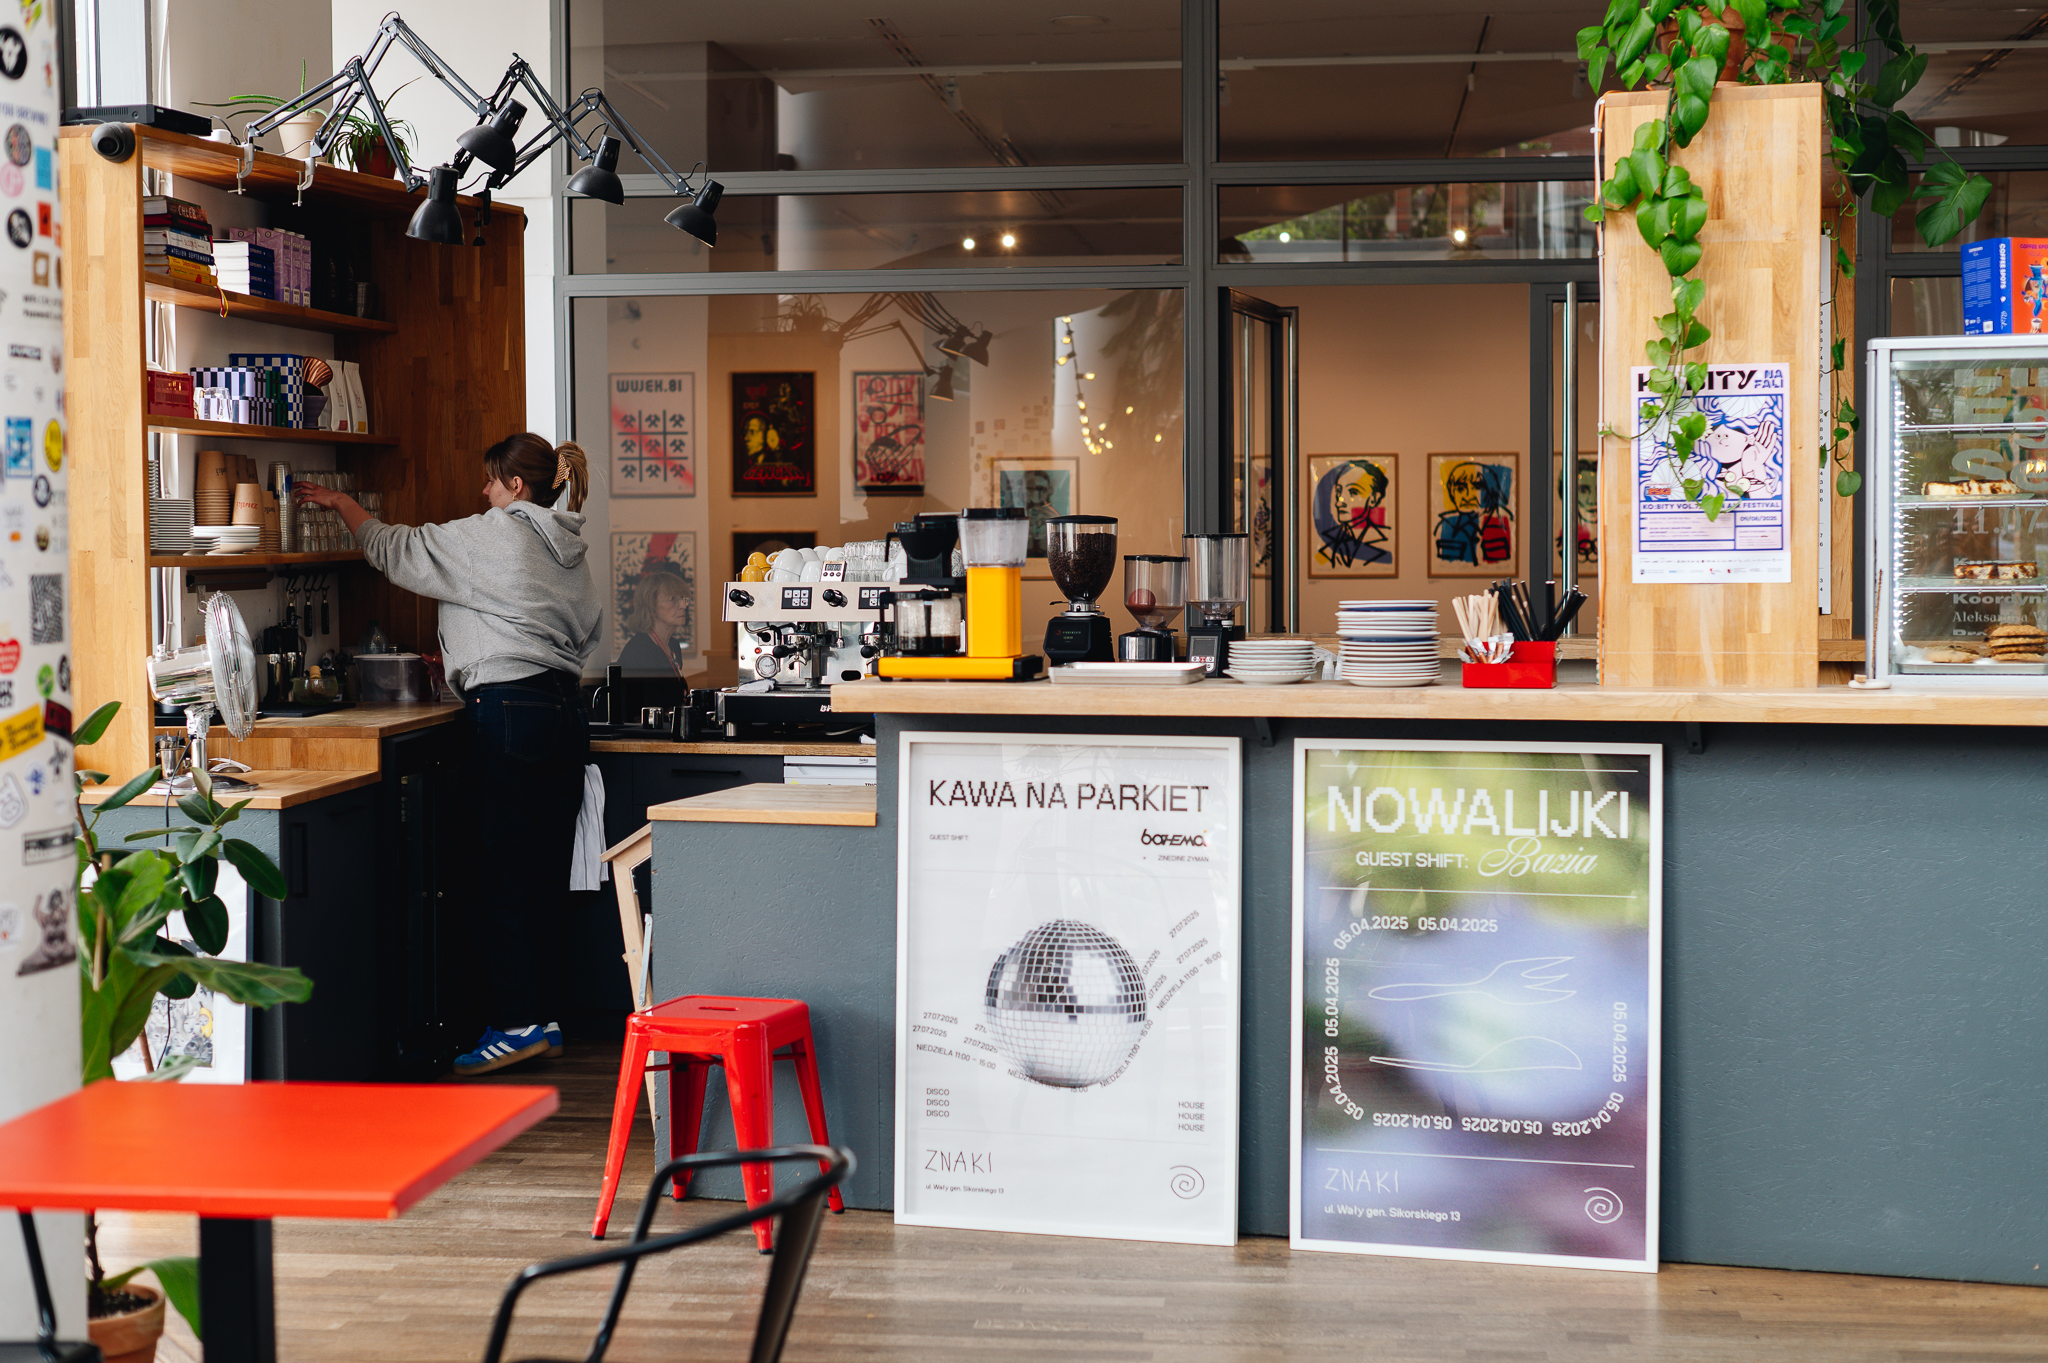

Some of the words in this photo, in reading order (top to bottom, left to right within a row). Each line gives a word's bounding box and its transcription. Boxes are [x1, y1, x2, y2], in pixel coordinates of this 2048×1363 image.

[1999, 243, 2007, 268] COFFEE
[1764, 370, 1783, 379] NA
[1743, 501, 1780, 509] FESTIVAL
[930, 780, 1016, 808] KAWA
[1027, 782, 1067, 809] NA
[1077, 783, 1209, 812] PARKIET
[1327, 785, 1629, 839] NOWALIJKI
[1355, 851, 1412, 867] GUEST
[1415, 852, 1469, 868] SHIFT:
[1477, 835, 1599, 877] Bazia
[1333, 915, 1409, 950] 05.04.2025
[1418, 917, 1498, 933] 05.04.2025
[1156, 979, 1186, 1011] NIEDZIELA
[1325, 957, 1340, 1037] 05.04.2025
[916, 1043, 953, 1056] NIEDZIELA
[1612, 1001, 1627, 1083] 05.04.2025
[1100, 1059, 1131, 1088] NIEDZIELA
[1325, 1046, 1364, 1120] 05.04.2025
[926, 1088, 950, 1096] DISCO
[926, 1099, 950, 1107] DISCO
[1178, 1101, 1205, 1109] HOUSE
[1551, 1091, 1624, 1136] 05.04.2025
[926, 1110, 950, 1118] DISCO
[1178, 1112, 1205, 1120] HOUSE
[1372, 1112, 1452, 1130] 05.04.2025
[1178, 1123, 1205, 1131] HOUSE
[1461, 1117, 1542, 1134] 05.04.2025
[925, 1149, 992, 1174] ZNAKI
[963, 1186, 997, 1195] Sikorskiego
[1325, 1167, 1398, 1193] ZNAKI
[1324, 1204, 1335, 1214] ul.
[1366, 1208, 1388, 1219] gen.
[1389, 1207, 1448, 1222] Sikorskiego
[1450, 1210, 1461, 1222] 13
